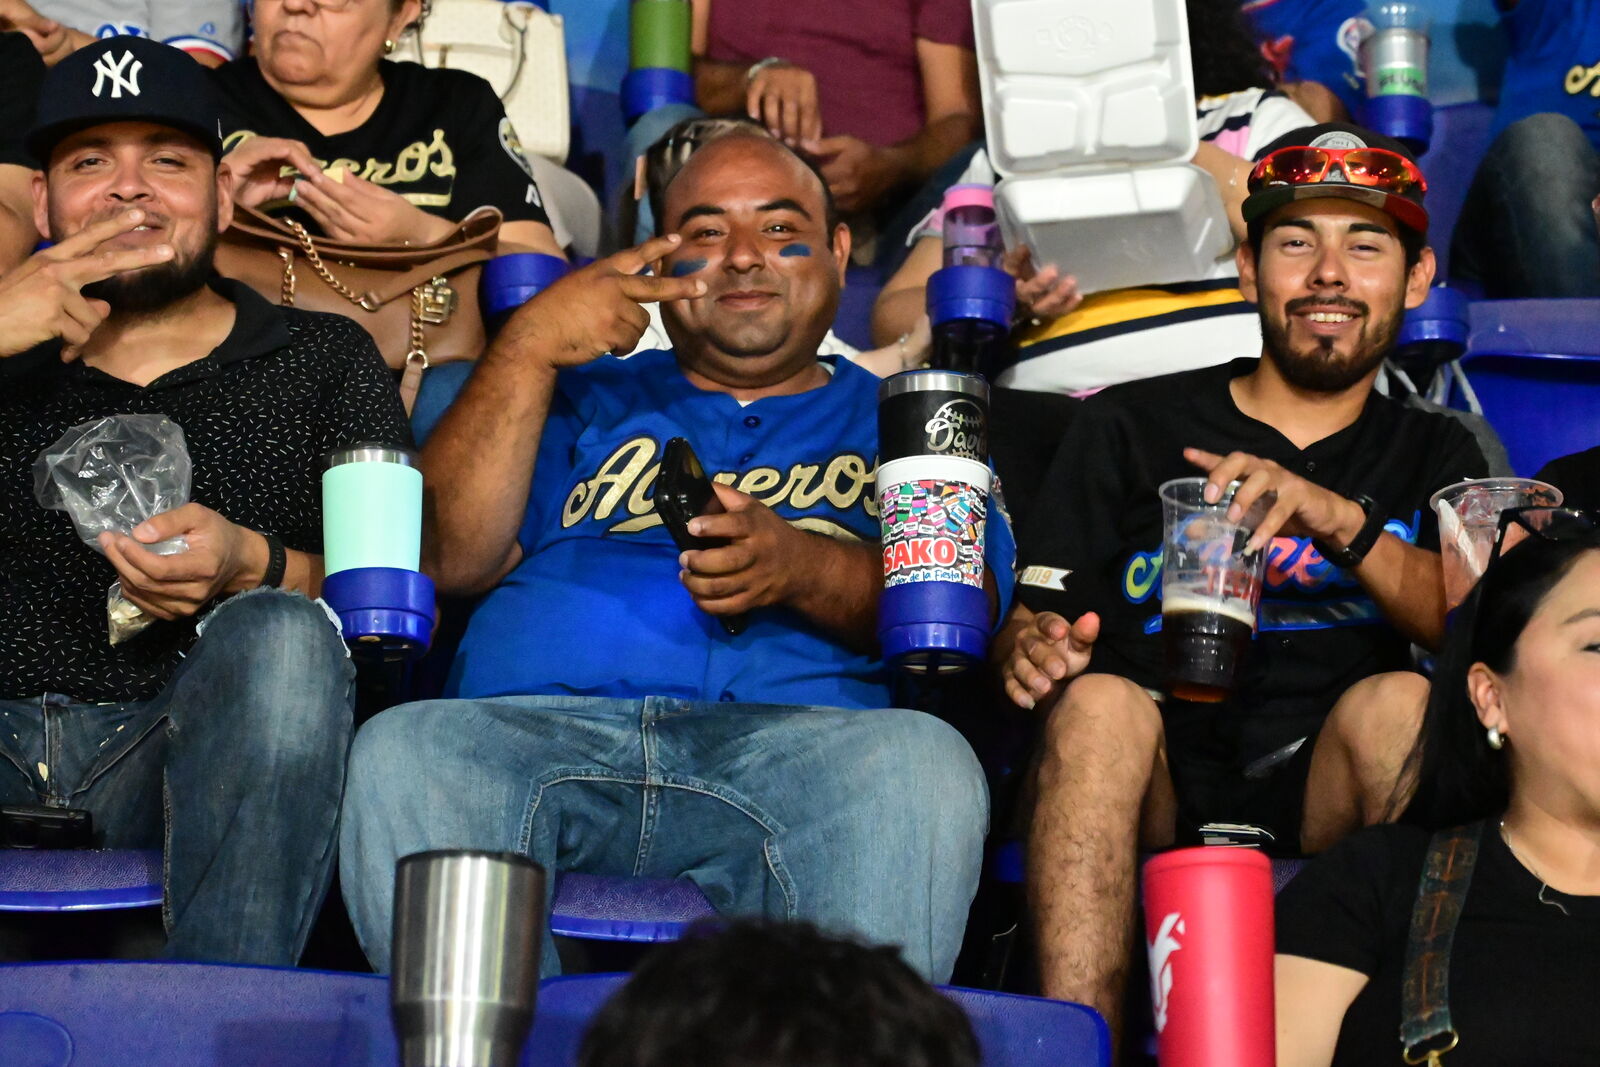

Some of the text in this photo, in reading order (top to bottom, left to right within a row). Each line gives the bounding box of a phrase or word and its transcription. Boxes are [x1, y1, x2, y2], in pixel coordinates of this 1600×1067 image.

[91, 49, 143, 98] NY
[922, 570, 931, 582] la
[934, 568, 961, 581] Fiesta
